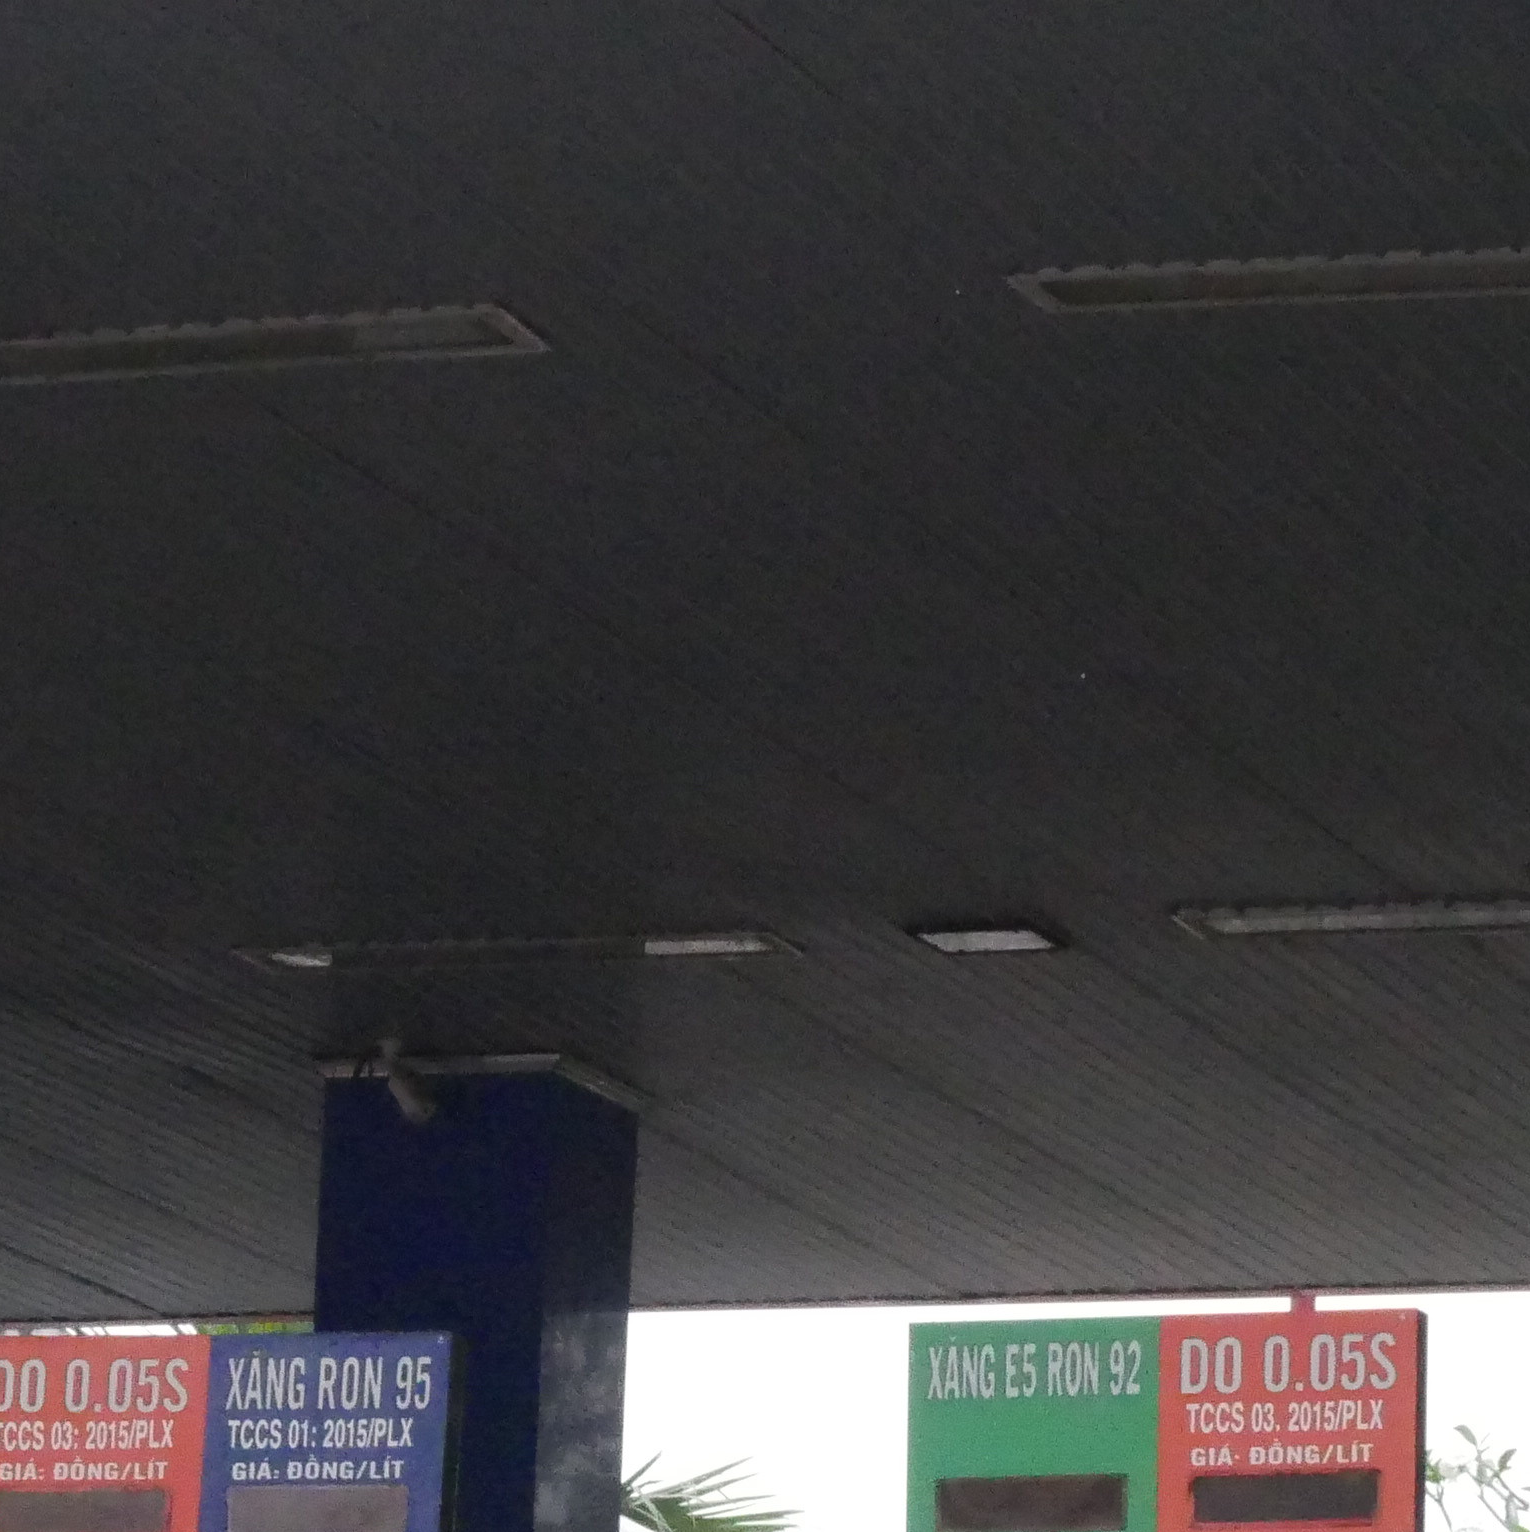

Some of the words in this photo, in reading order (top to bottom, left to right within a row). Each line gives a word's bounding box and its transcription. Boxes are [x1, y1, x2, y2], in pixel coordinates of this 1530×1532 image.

[64, 1357, 190, 1413] 0.05S
[225, 1353, 306, 1411] XĂNG
[317, 1356, 383, 1410] RON
[396, 1355, 431, 1410] 95
[927, 1337, 996, 1399] XĂNG
[1006, 1344, 1036, 1398] E5
[1048, 1341, 1099, 1397] RON
[1110, 1339, 1142, 1395] 92
[1180, 1336, 1243, 1395] DO
[1263, 1333, 1398, 1392] 0.05S
[50, 1421, 78, 1451] 03:
[85, 1420, 173, 1450] 2015/PLX
[229, 1420, 282, 1449] TCCS
[288, 1420, 317, 1449] 01:
[323, 1418, 414, 1448] 2015/PLX
[1186, 1402, 1245, 1434] TCCS
[1287, 1399, 1384, 1432] 2015/PLX
